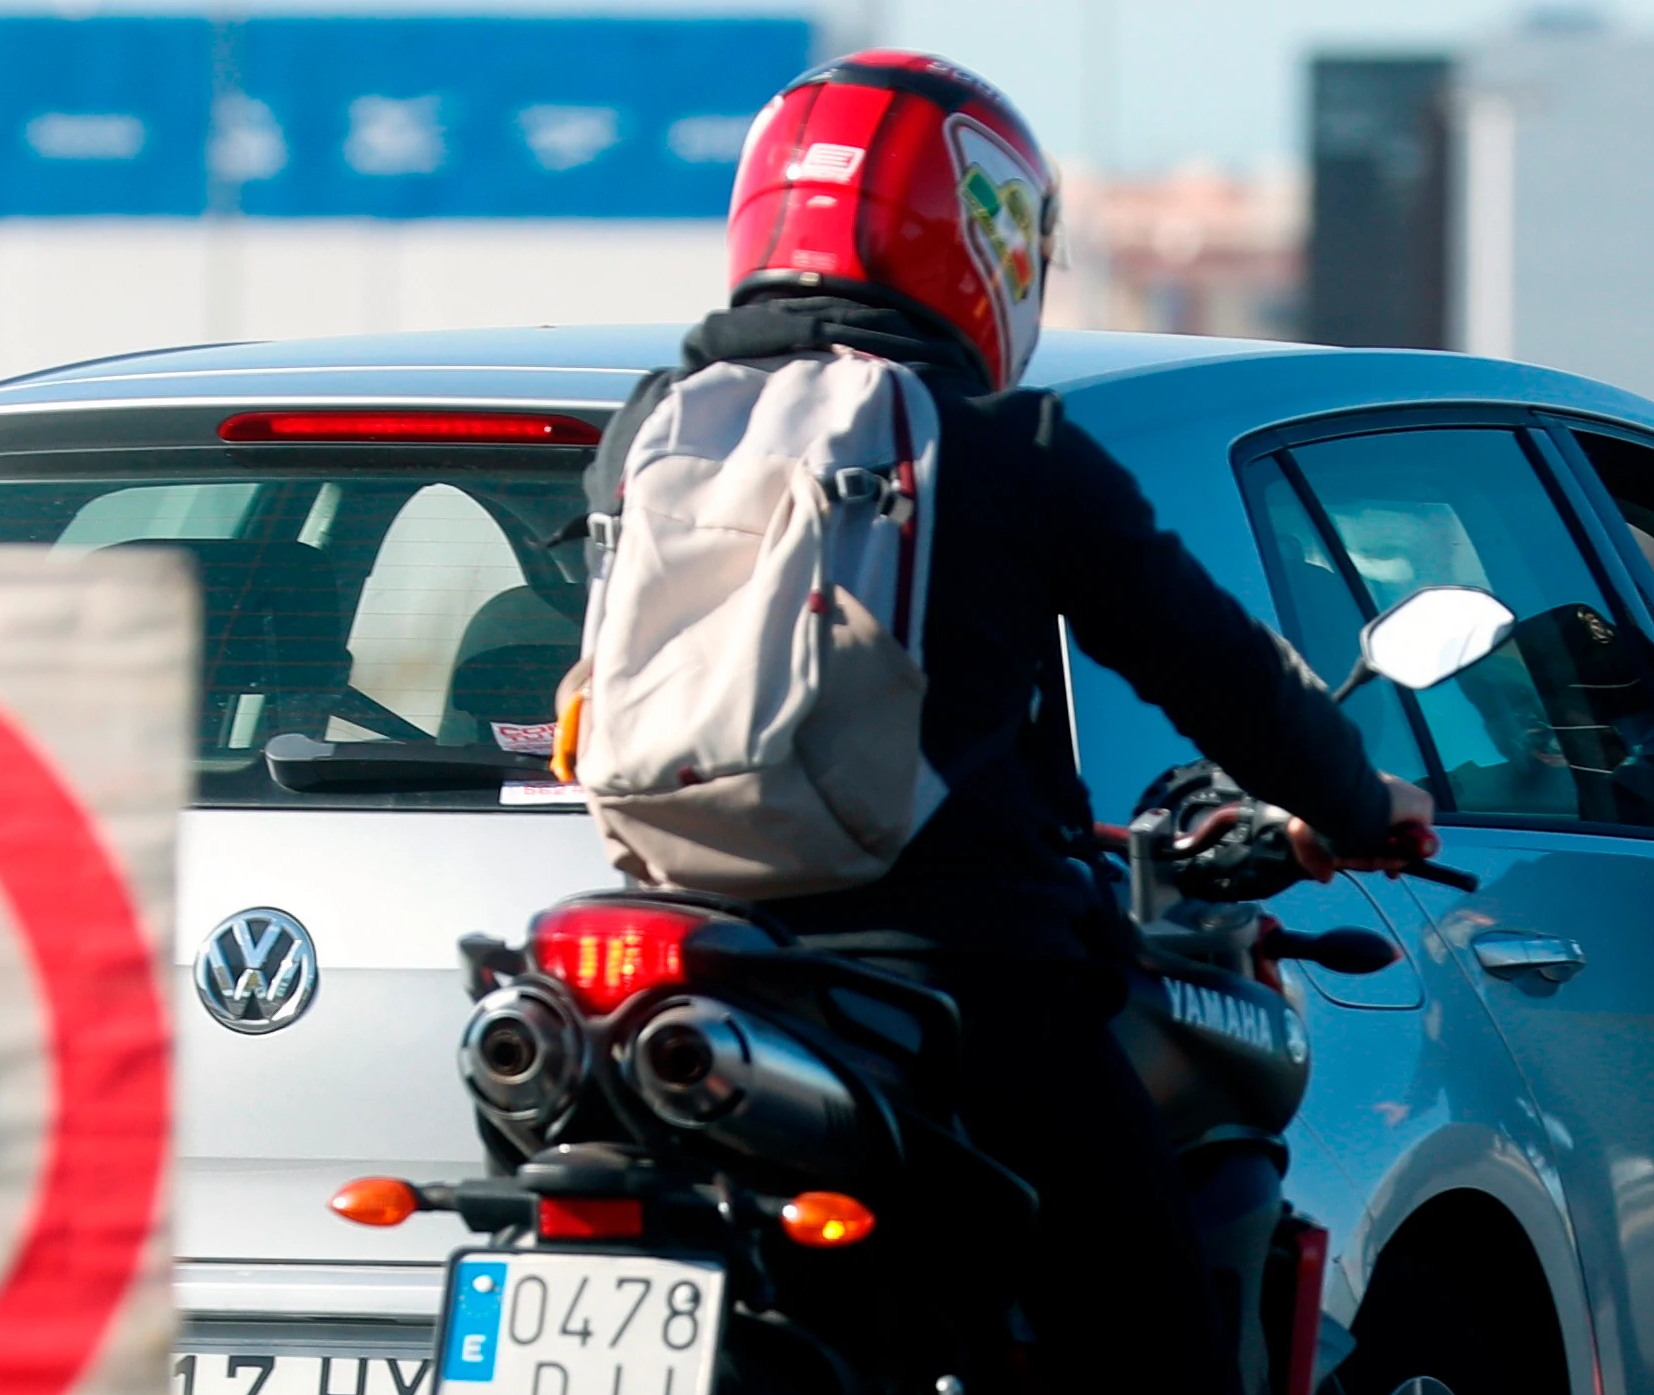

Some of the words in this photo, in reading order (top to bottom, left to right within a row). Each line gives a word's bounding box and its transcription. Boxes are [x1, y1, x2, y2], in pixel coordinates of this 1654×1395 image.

[1162, 976, 1273, 1052] YAMAHA
[461, 1334, 487, 1363] E
[509, 1274, 702, 1350] 0478
